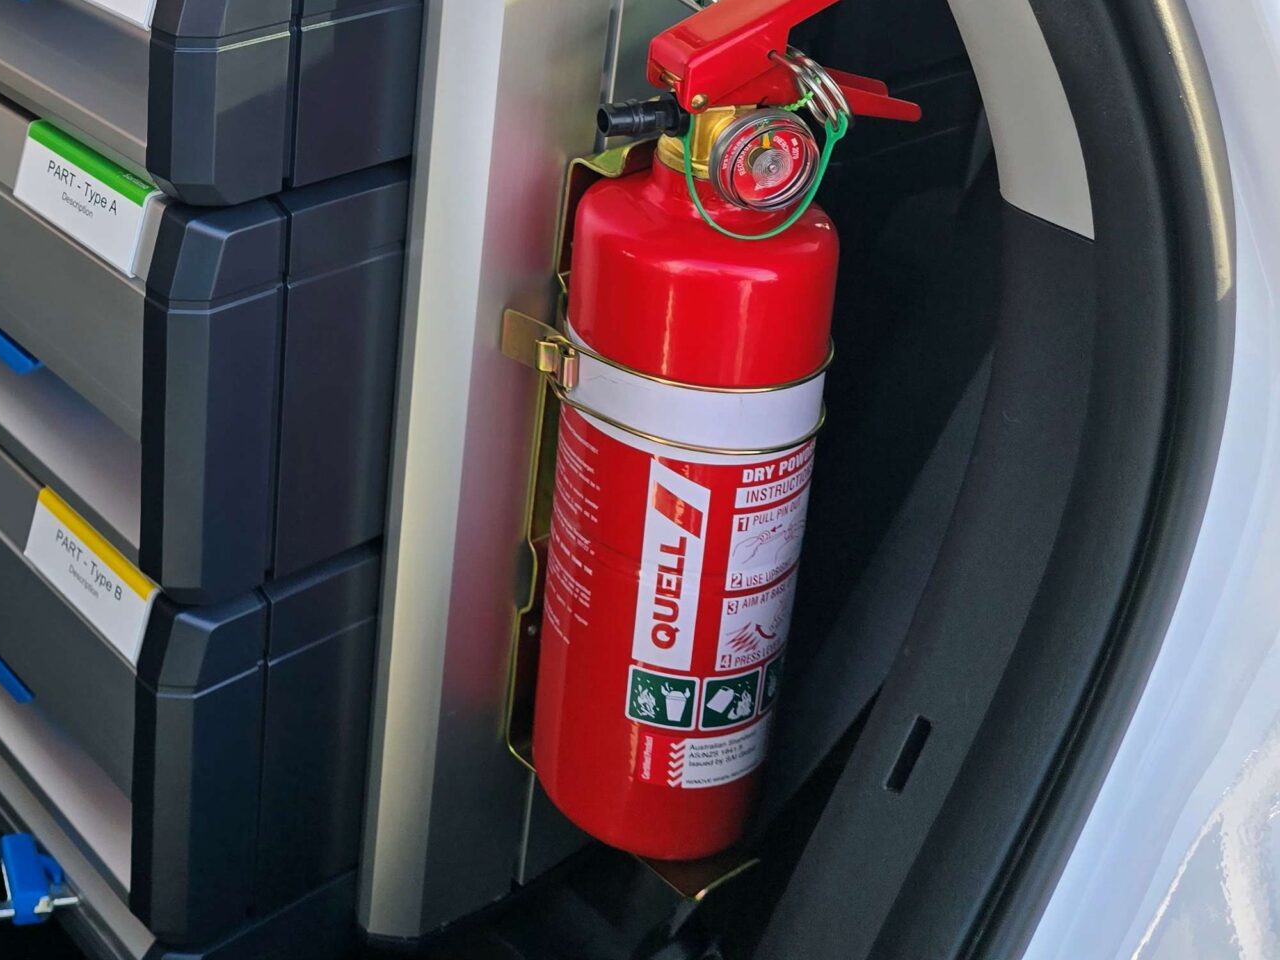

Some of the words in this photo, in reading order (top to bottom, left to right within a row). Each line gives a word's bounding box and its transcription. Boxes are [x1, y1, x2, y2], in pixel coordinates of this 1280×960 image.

[47, 160, 76, 187] PART
[84, 181, 108, 209] Type
[108, 199, 118, 216] A
[62, 192, 94, 218] Description
[742, 464, 776, 484] DRY
[752, 510, 773, 526] PULL
[776, 506, 790, 520] PIN
[56, 529, 82, 562] PART
[90, 560, 112, 591] Type
[114, 585, 122, 600] B
[730, 572, 742, 588] 2
[746, 574, 764, 587] USE
[651, 536, 688, 650] QUELL
[726, 600, 739, 615] 3
[742, 597, 758, 609] AIM
[760, 592, 770, 605] AT
[720, 654, 732, 668] 4
[734, 649, 760, 667] PRESS
